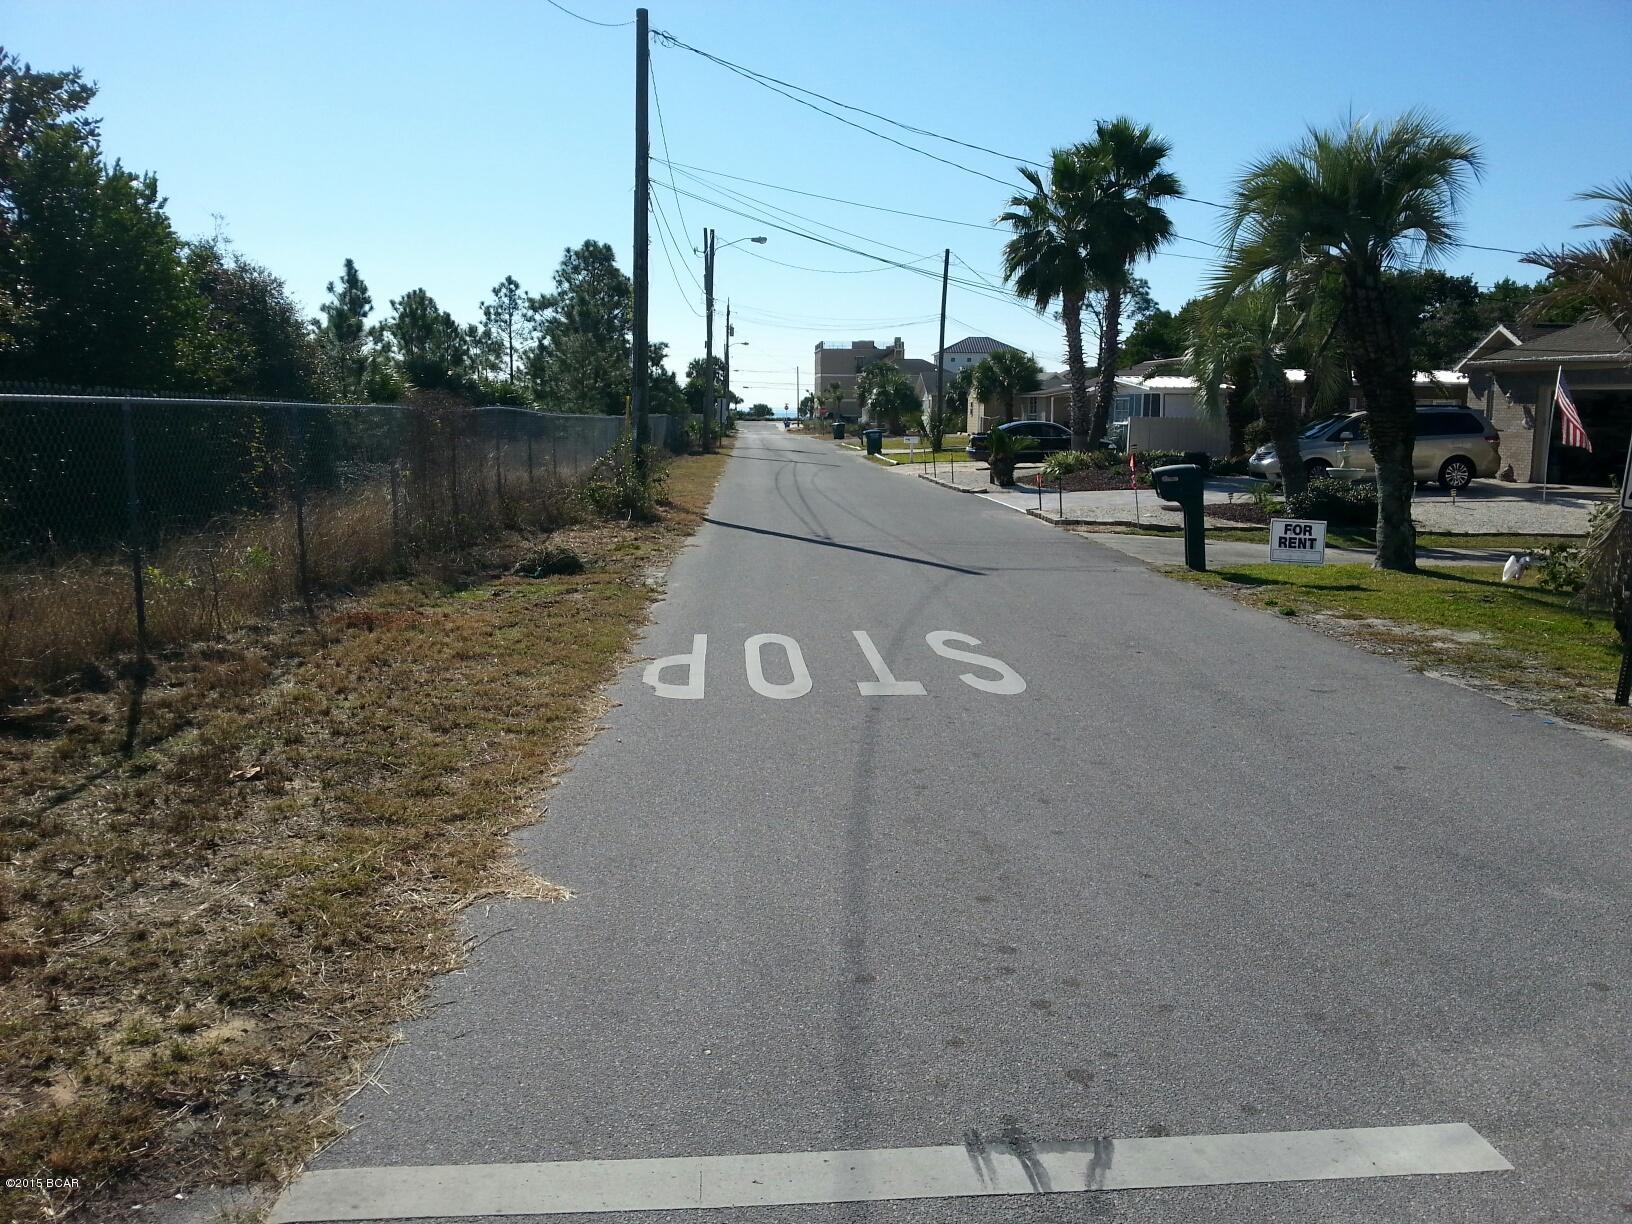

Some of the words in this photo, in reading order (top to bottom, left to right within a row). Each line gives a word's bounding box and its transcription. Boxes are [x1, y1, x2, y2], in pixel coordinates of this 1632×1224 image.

[1284, 523, 1313, 537] FOR
[1278, 536, 1317, 550] RENT
[642, 630, 1027, 700] STOP
